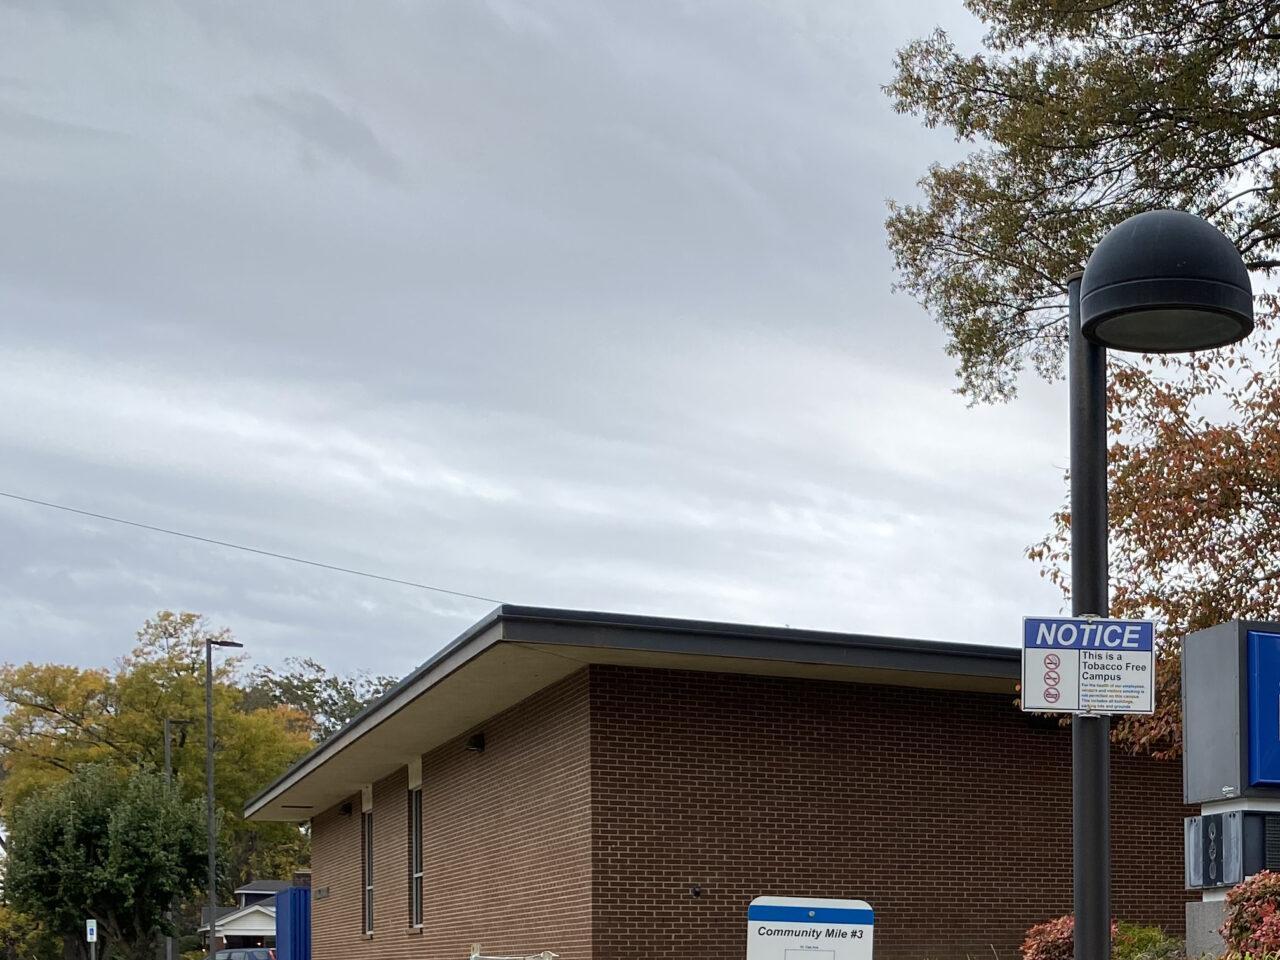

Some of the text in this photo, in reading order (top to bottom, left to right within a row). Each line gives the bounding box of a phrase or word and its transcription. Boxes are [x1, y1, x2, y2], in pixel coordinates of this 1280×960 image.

[1036, 623, 1141, 648] NOTICE
[1082, 651, 1102, 660] This
[1106, 652, 1114, 660] is
[1082, 662, 1147, 671] Tobacco Free
[1082, 672, 1121, 682] Campus
[758, 926, 863, 939] Community Mile #3
